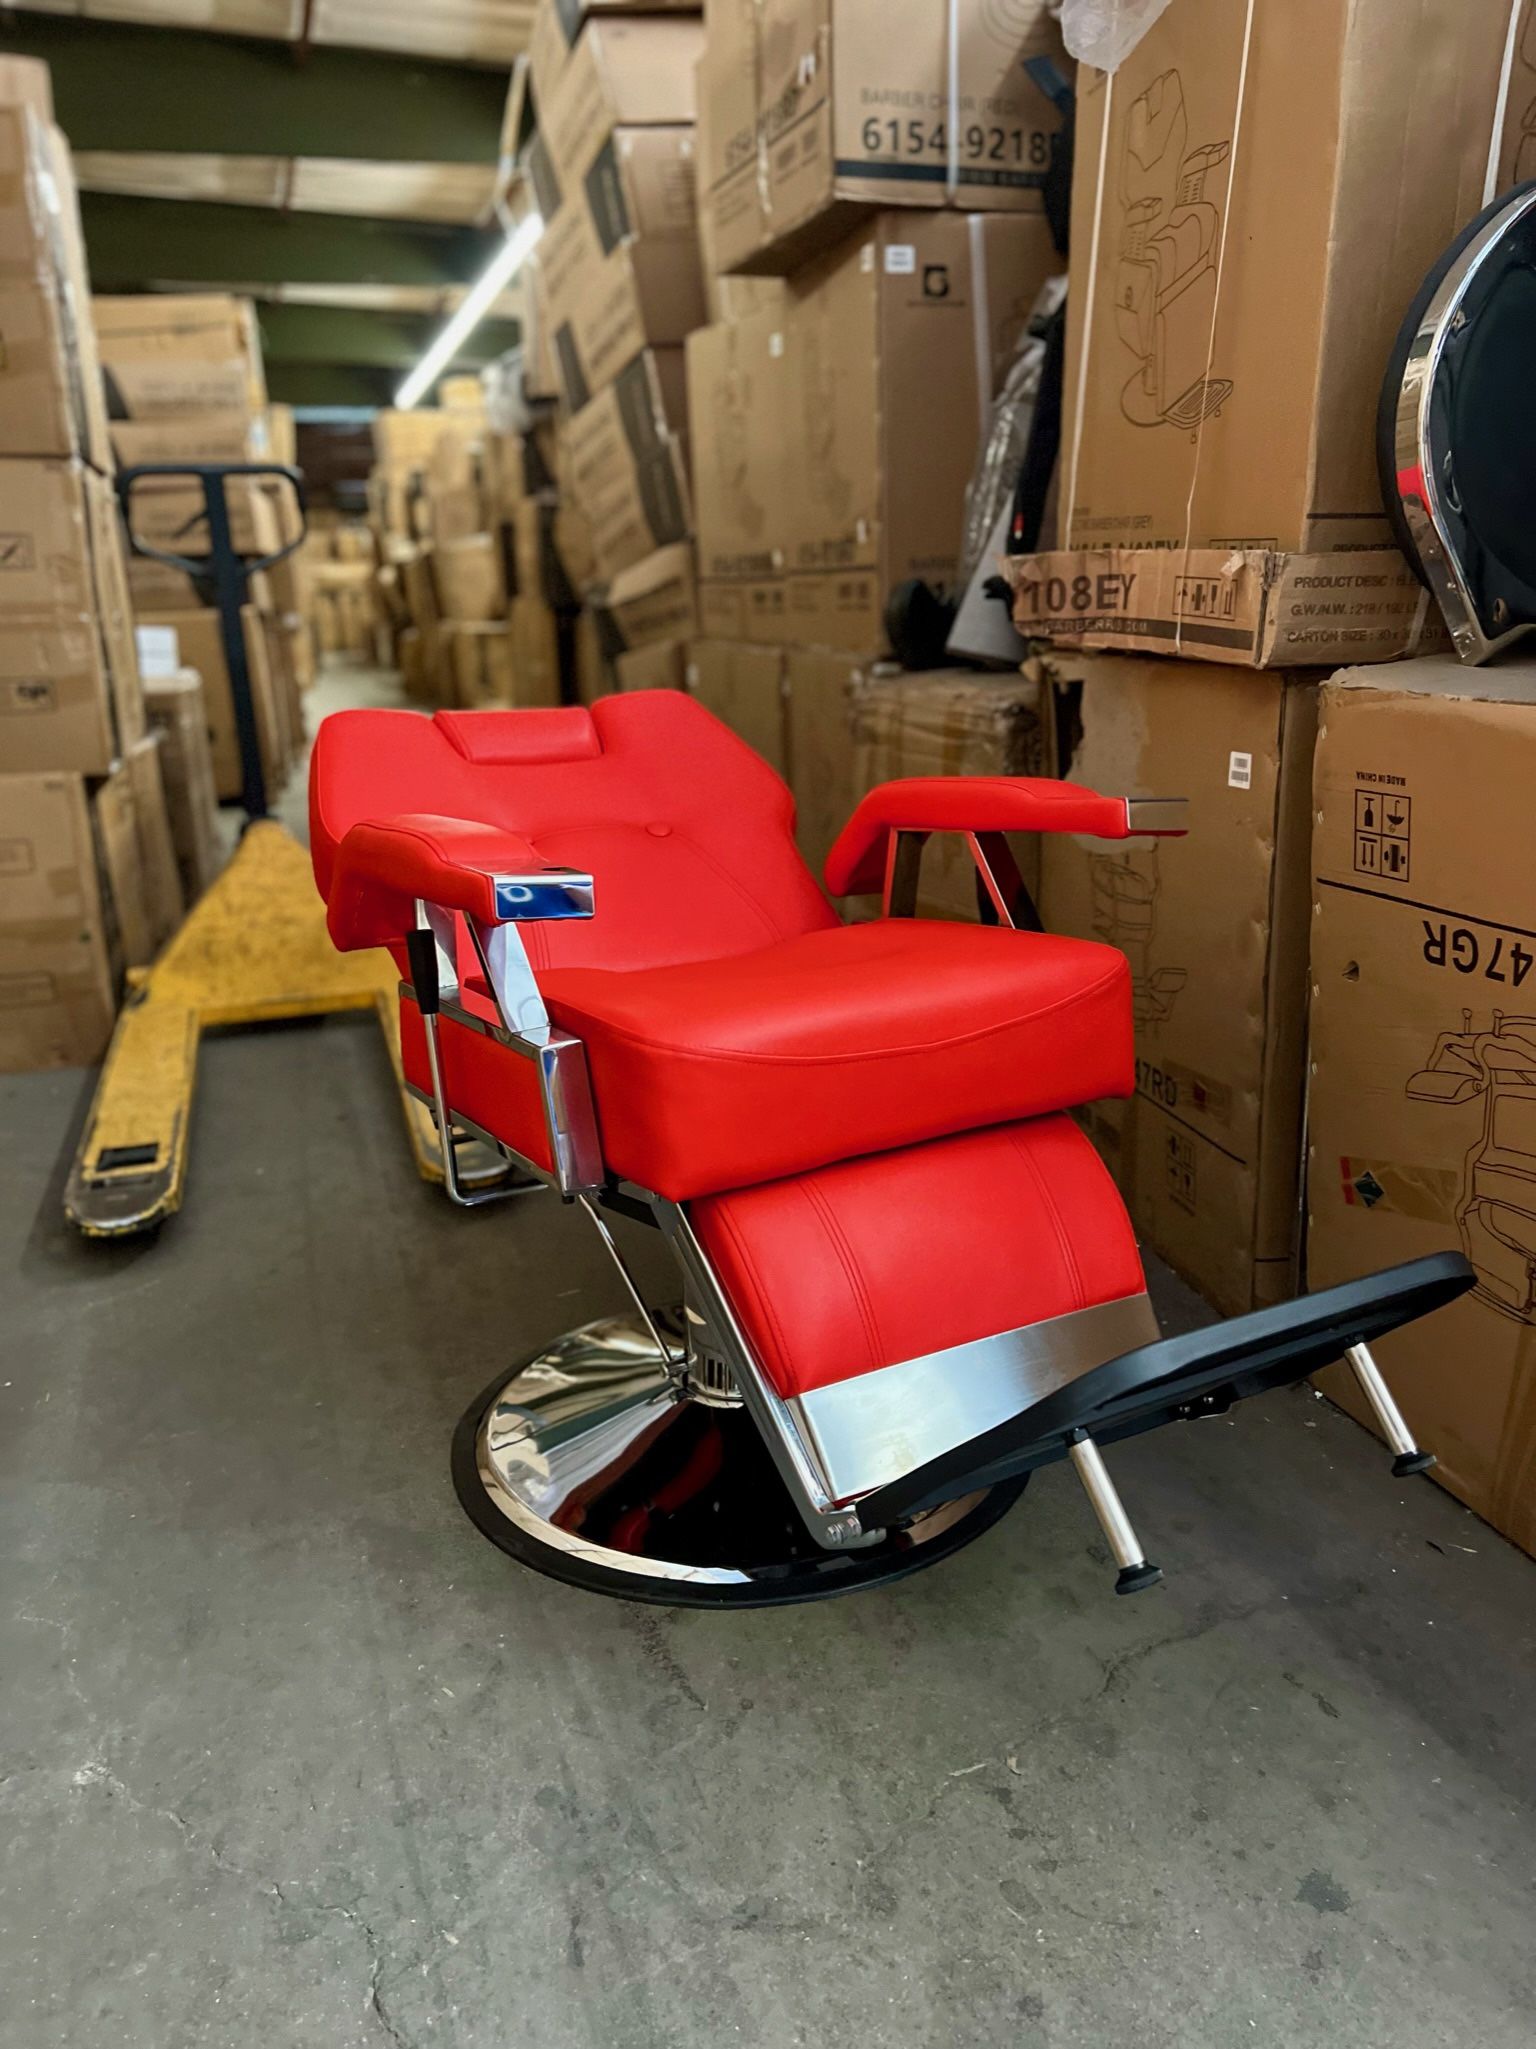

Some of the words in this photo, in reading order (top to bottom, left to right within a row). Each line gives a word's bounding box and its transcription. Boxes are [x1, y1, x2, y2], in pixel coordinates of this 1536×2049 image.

[861, 118, 1058, 164] 6154-9218
[1294, 575, 1352, 588] PRODUCT
[1287, 630, 1339, 643] CARTON
[1356, 771, 1377, 783] CHINA
[1387, 775, 1407, 787] MADE
[1422, 920, 1535, 987] 47GR
